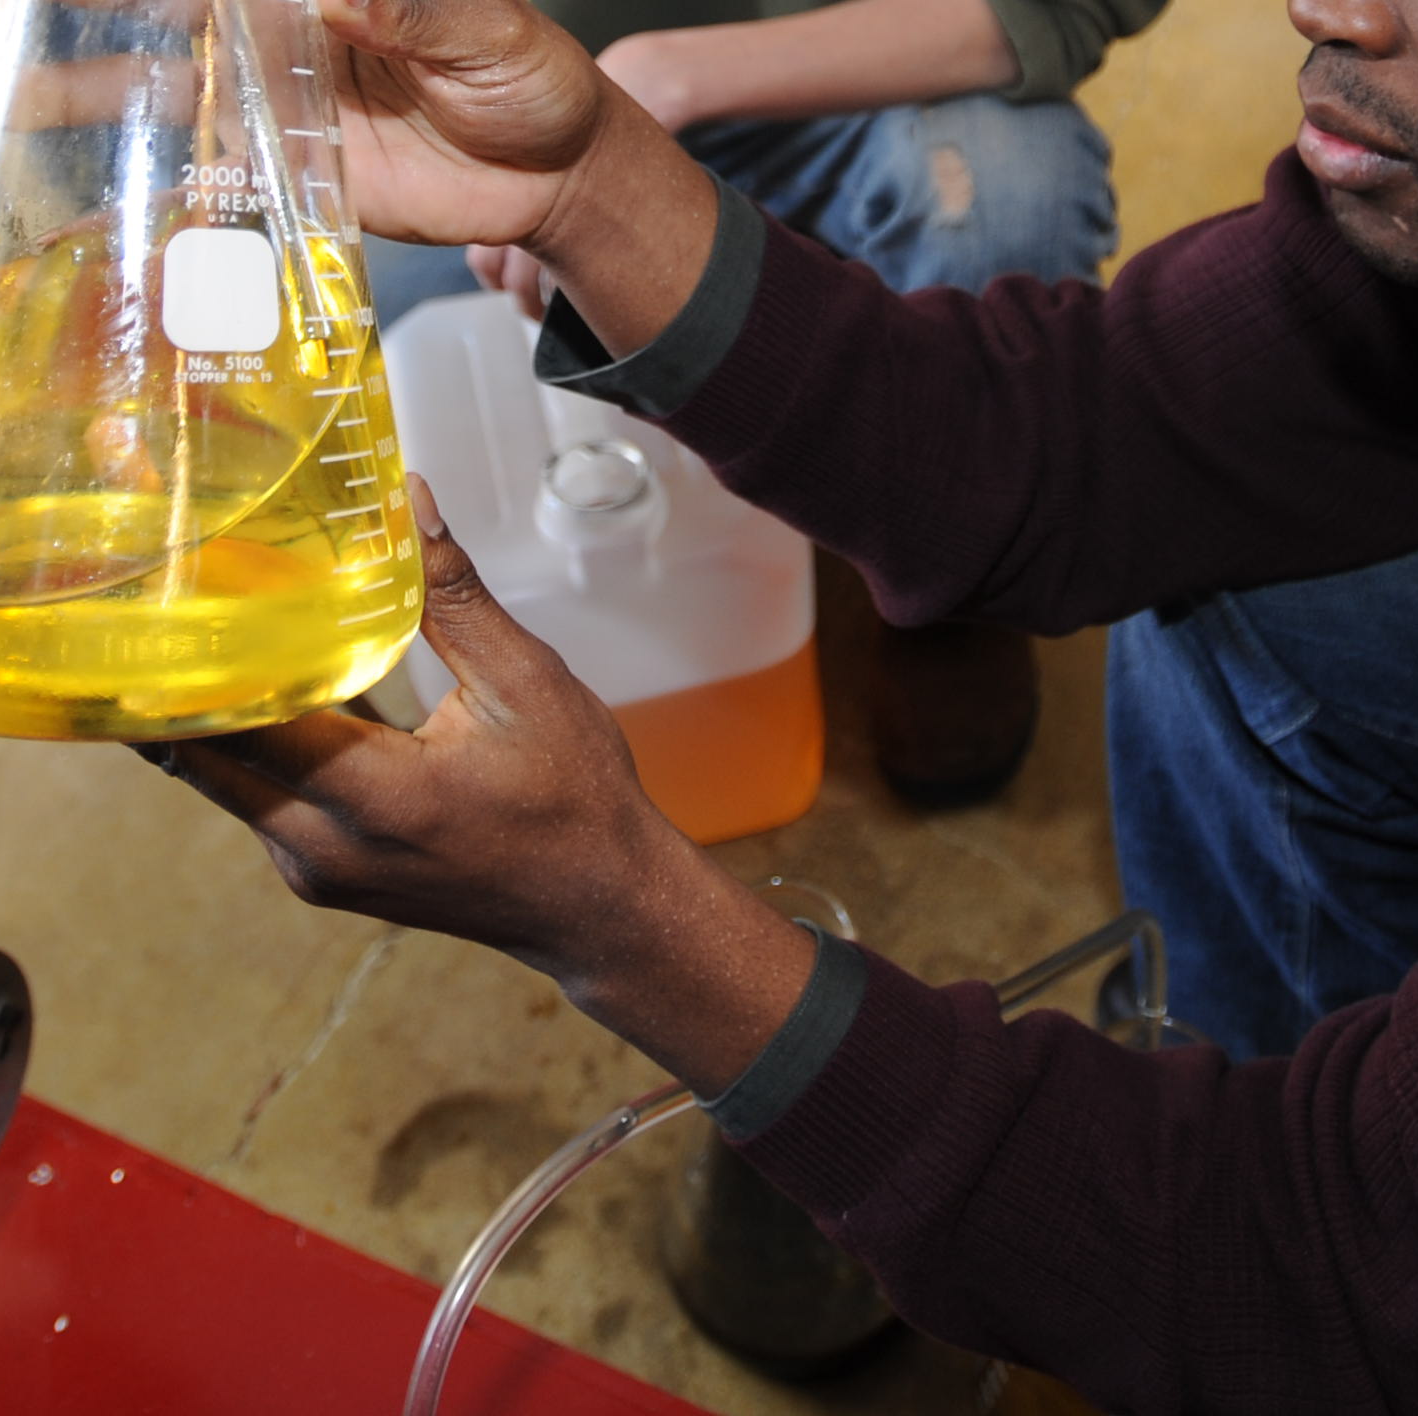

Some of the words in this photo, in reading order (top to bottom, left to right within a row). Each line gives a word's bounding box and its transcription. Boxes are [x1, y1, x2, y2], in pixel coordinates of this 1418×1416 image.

[181, 164, 246, 187] 2000
[187, 356, 218, 371] No.
[224, 356, 264, 371] 5100
[174, 371, 228, 383] STOPPER
[396, 537, 413, 562] 600
[403, 585, 419, 609] 400
